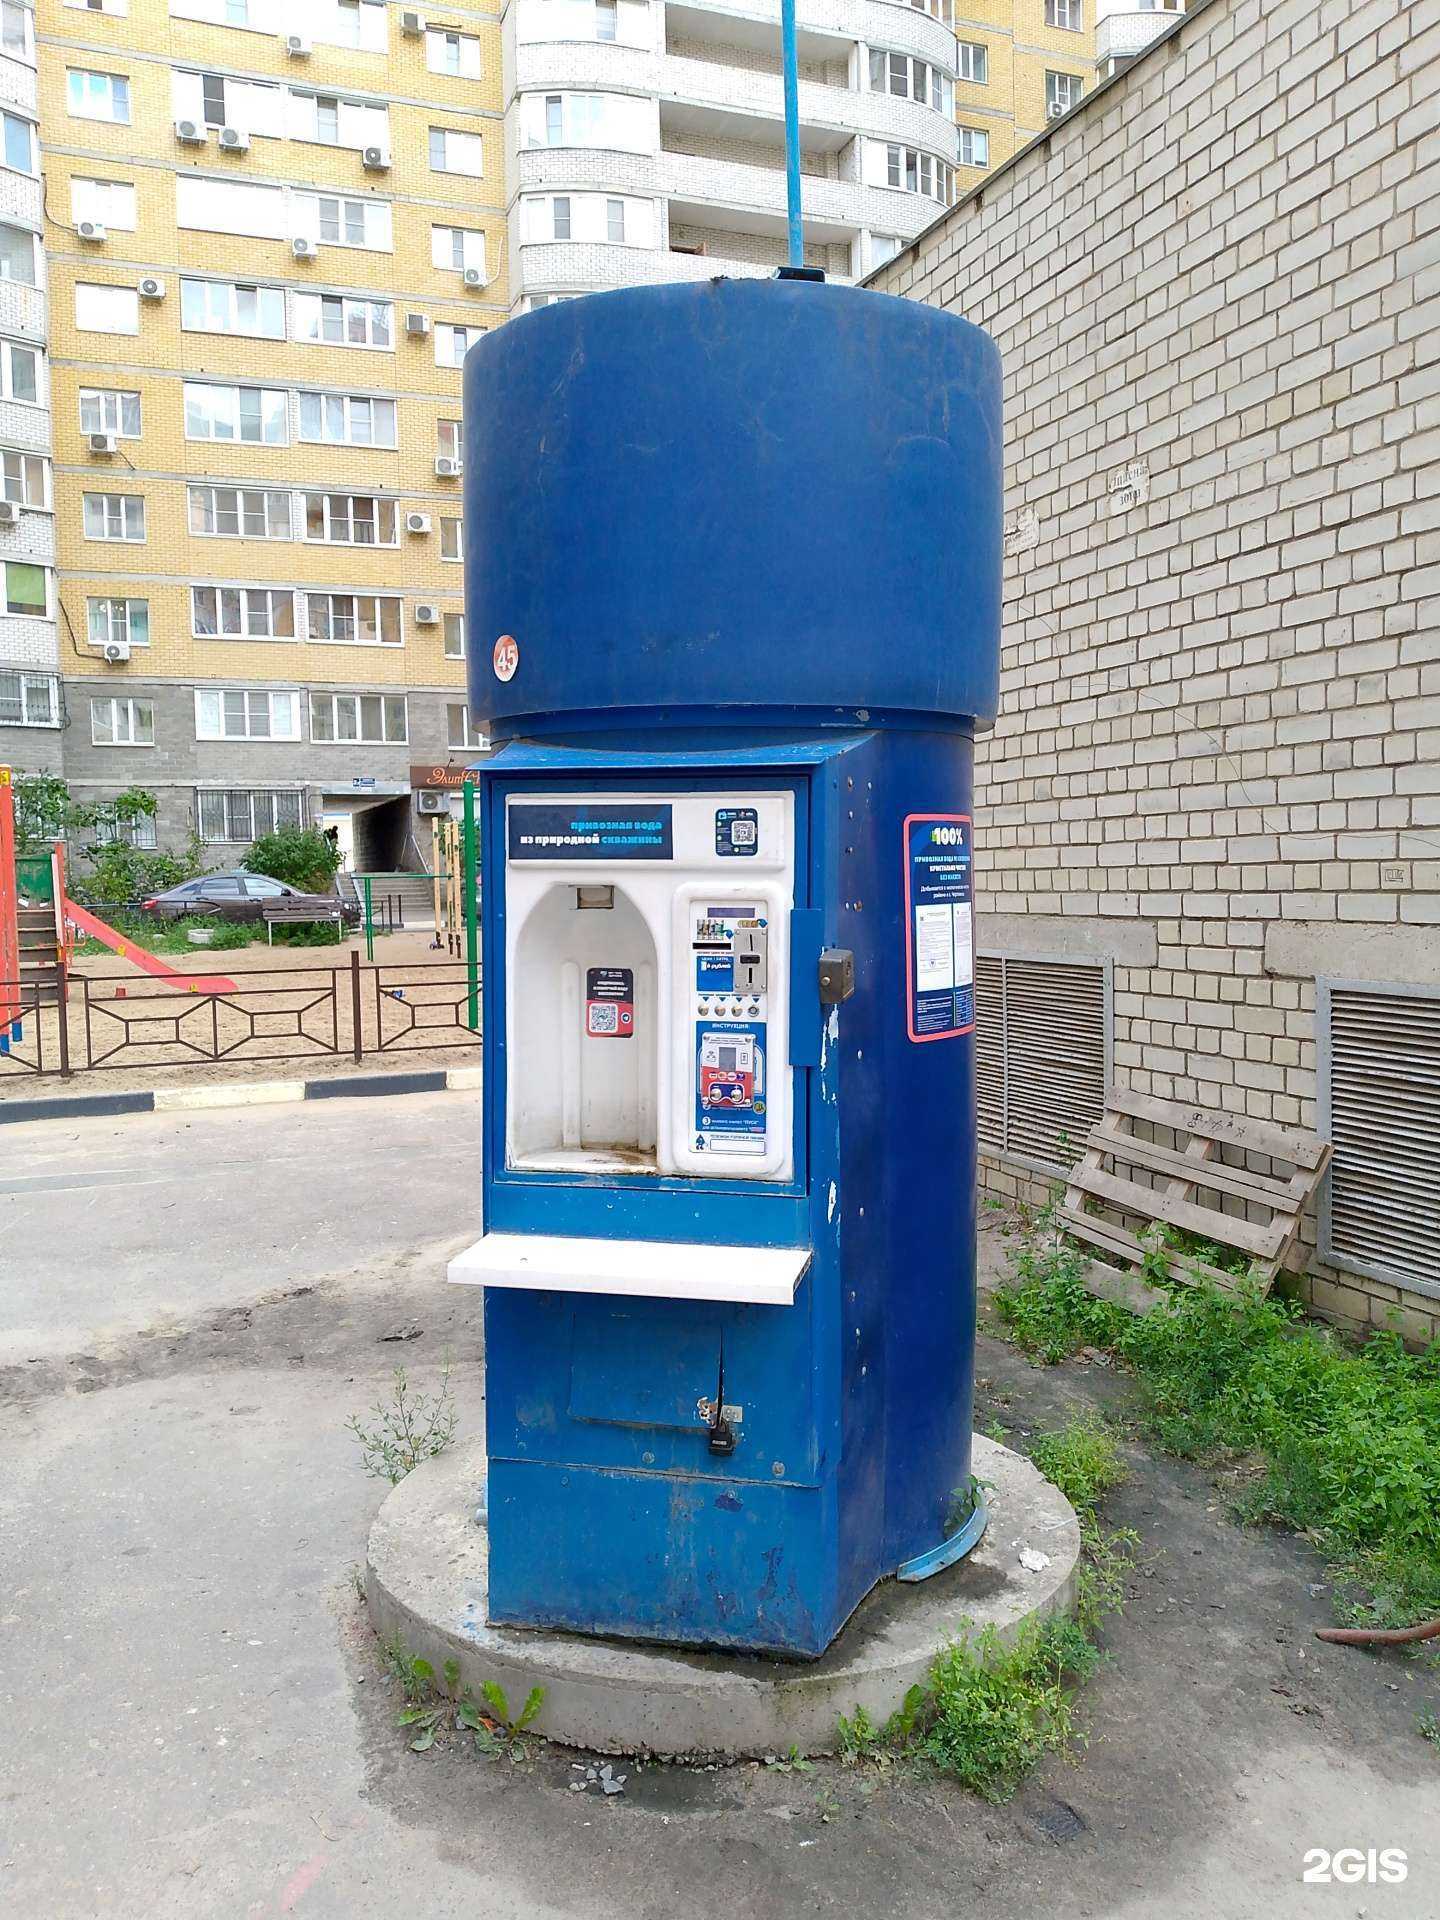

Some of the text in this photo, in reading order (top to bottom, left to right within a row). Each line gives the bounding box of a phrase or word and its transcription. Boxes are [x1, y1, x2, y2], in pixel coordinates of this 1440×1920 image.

[497, 645, 516, 671] 45
[634, 821, 663, 831] вода
[520, 835, 534, 844] из
[534, 833, 600, 847] природной
[934, 827, 963, 845] 100%
